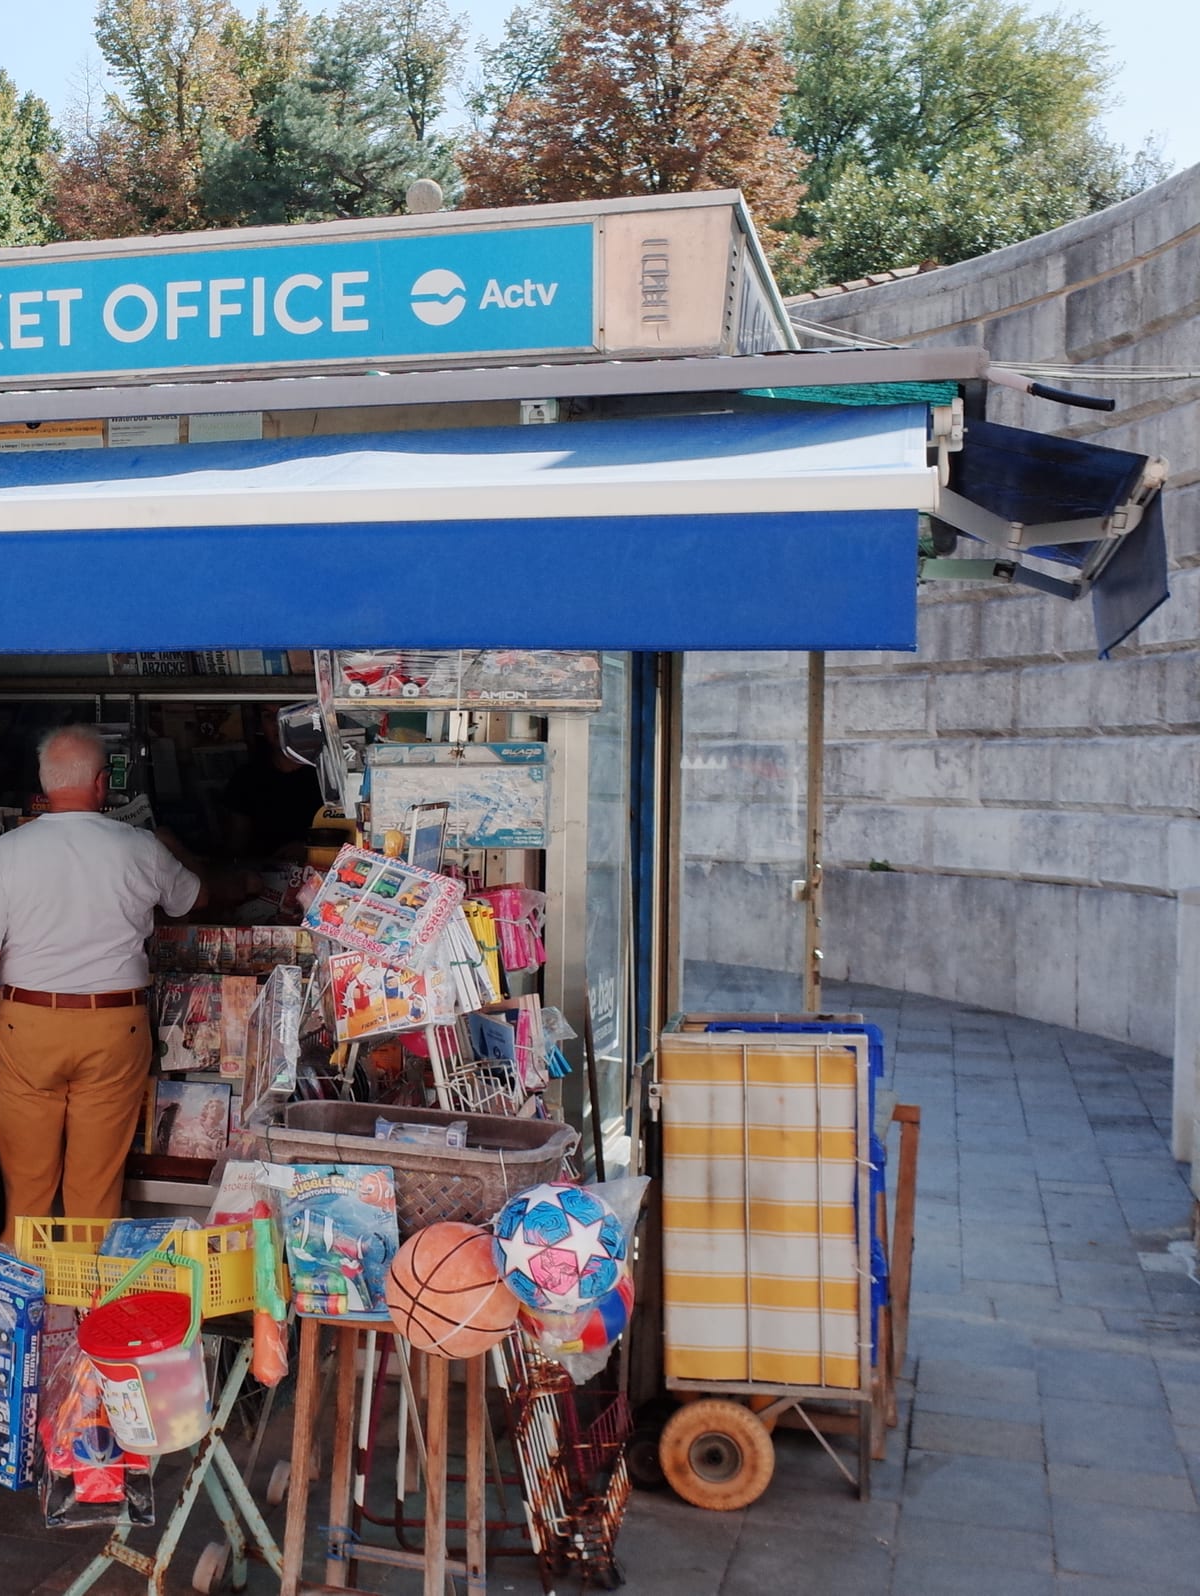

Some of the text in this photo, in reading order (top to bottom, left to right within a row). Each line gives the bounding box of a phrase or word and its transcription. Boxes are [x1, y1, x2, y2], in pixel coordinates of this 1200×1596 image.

[479, 278, 558, 310] Actv
[102, 270, 369, 343] OFFICE
[142, 662, 185, 674] ABZOCKE
[467, 690, 528, 699] CAMION
[323, 809, 346, 819] Rico
[19, 1391, 38, 1484] POLICE
